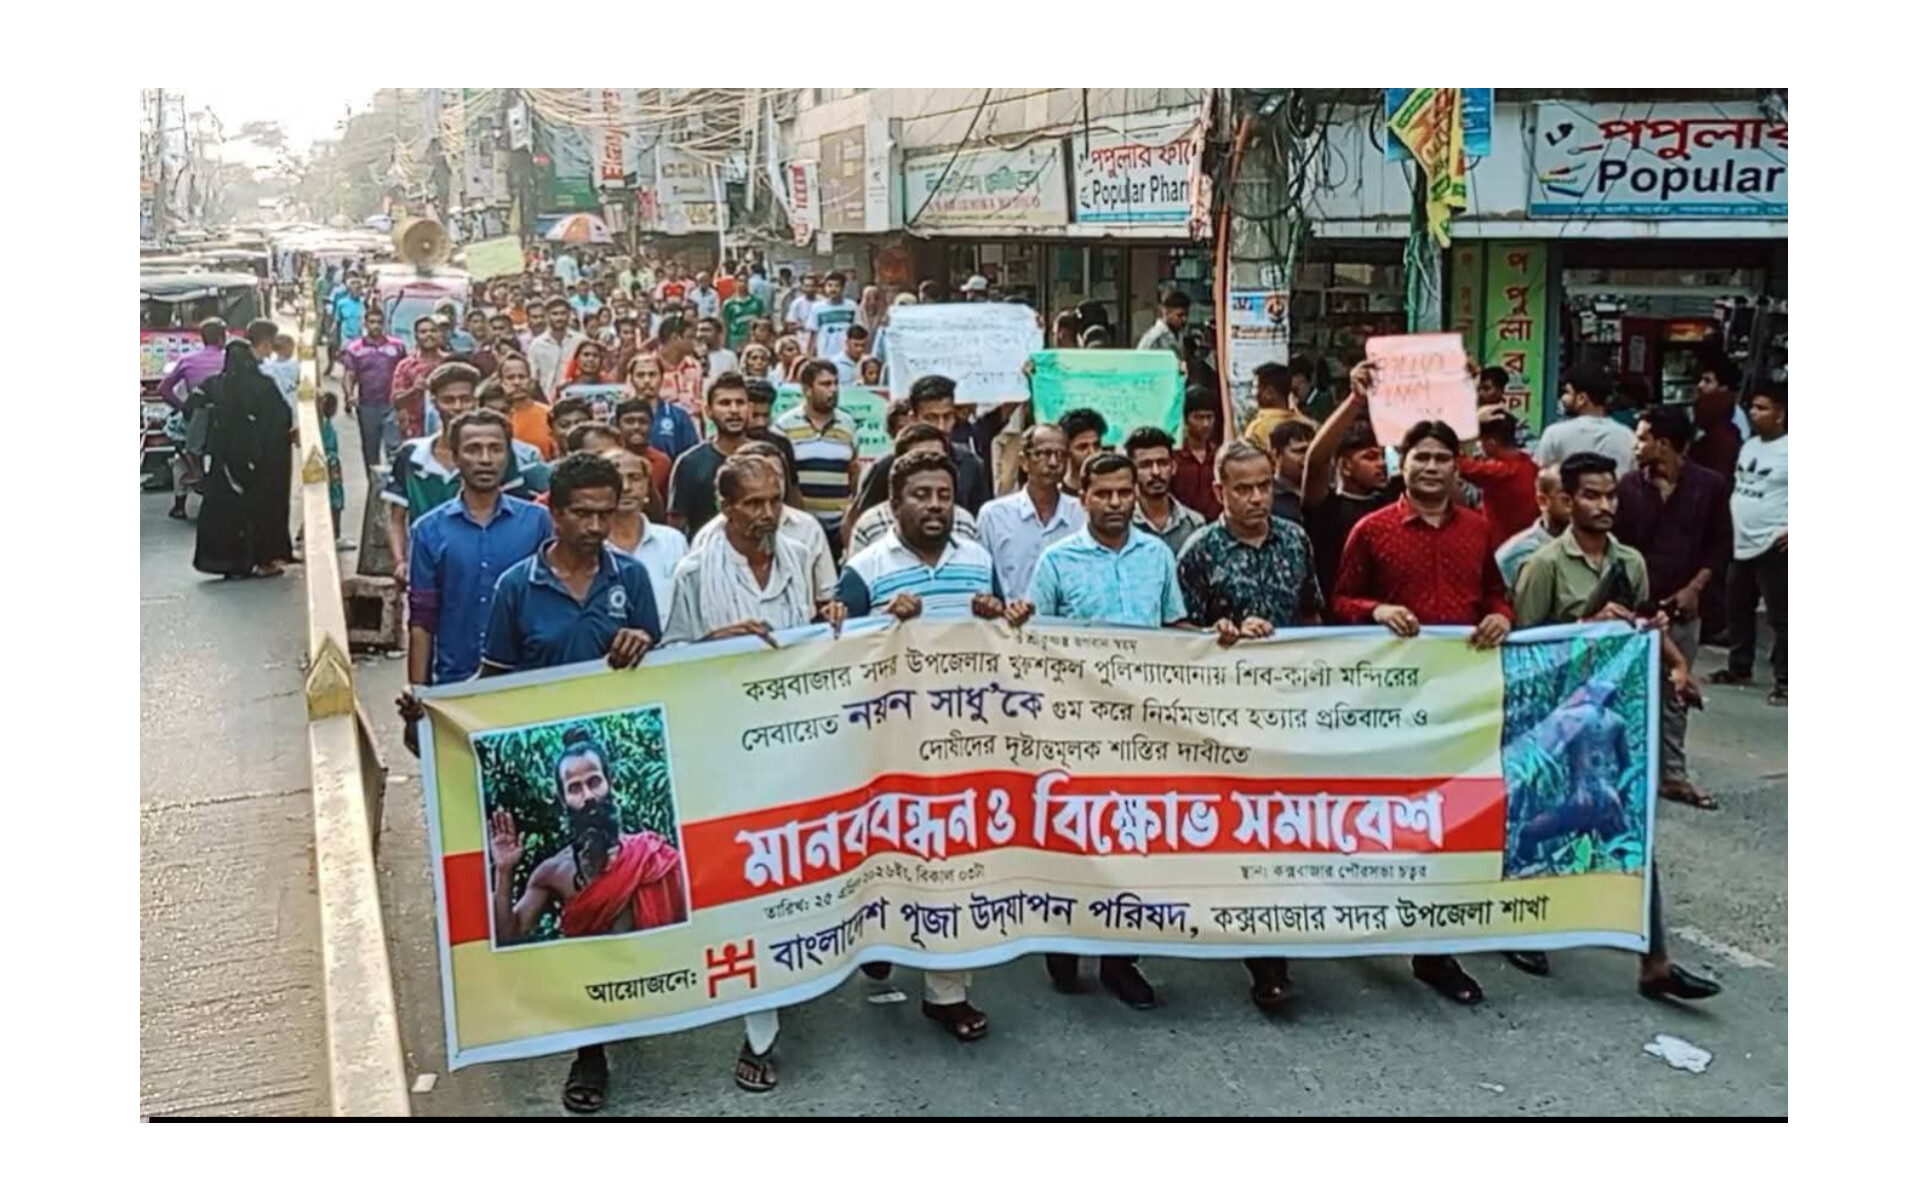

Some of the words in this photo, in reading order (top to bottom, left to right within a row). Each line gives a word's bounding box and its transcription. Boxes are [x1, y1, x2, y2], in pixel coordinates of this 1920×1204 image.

[1091, 143, 1151, 178] পপুলার
[1597, 158, 1787, 200] Popular
[1092, 178, 1146, 210] Popular
[742, 666, 852, 702] কক্সবাজার
[906, 647, 1000, 675] উপজেলার
[1236, 659, 1334, 687] শিব-কালী
[1339, 660, 1421, 688] মন্দিরের
[741, 714, 840, 751] সেবায়েত
[842, 690, 917, 730] নয়ন
[1052, 699, 1083, 721] গুম
[1089, 699, 1135, 722] করে
[1143, 697, 1239, 728] নির্মমভাবে
[1246, 707, 1308, 730] হত্যার
[1315, 701, 1402, 731] প্রতিবাদে
[1412, 708, 1428, 727] ও
[919, 728, 998, 761] দোষীদের
[1004, 731, 1101, 768] দৃষ্টান্তমূলক
[1108, 733, 1171, 762] শাস্তির
[1177, 738, 1252, 765] দাবীতে
[734, 787, 979, 888] মানববন্ধন
[986, 787, 1017, 845] ও
[1032, 769, 1222, 858] বিক্ষোভ
[1230, 788, 1448, 855] সমাবেশ
[769, 895, 889, 973] বাংলাদেশ
[899, 898, 963, 950] পূজা
[1088, 892, 1200, 939] পরিষদ,
[1210, 903, 1328, 936] কক্সবাজার
[1334, 902, 1390, 931] সদর
[1395, 896, 1495, 929] উপজেলা
[1500, 895, 1551, 922] শাখা
